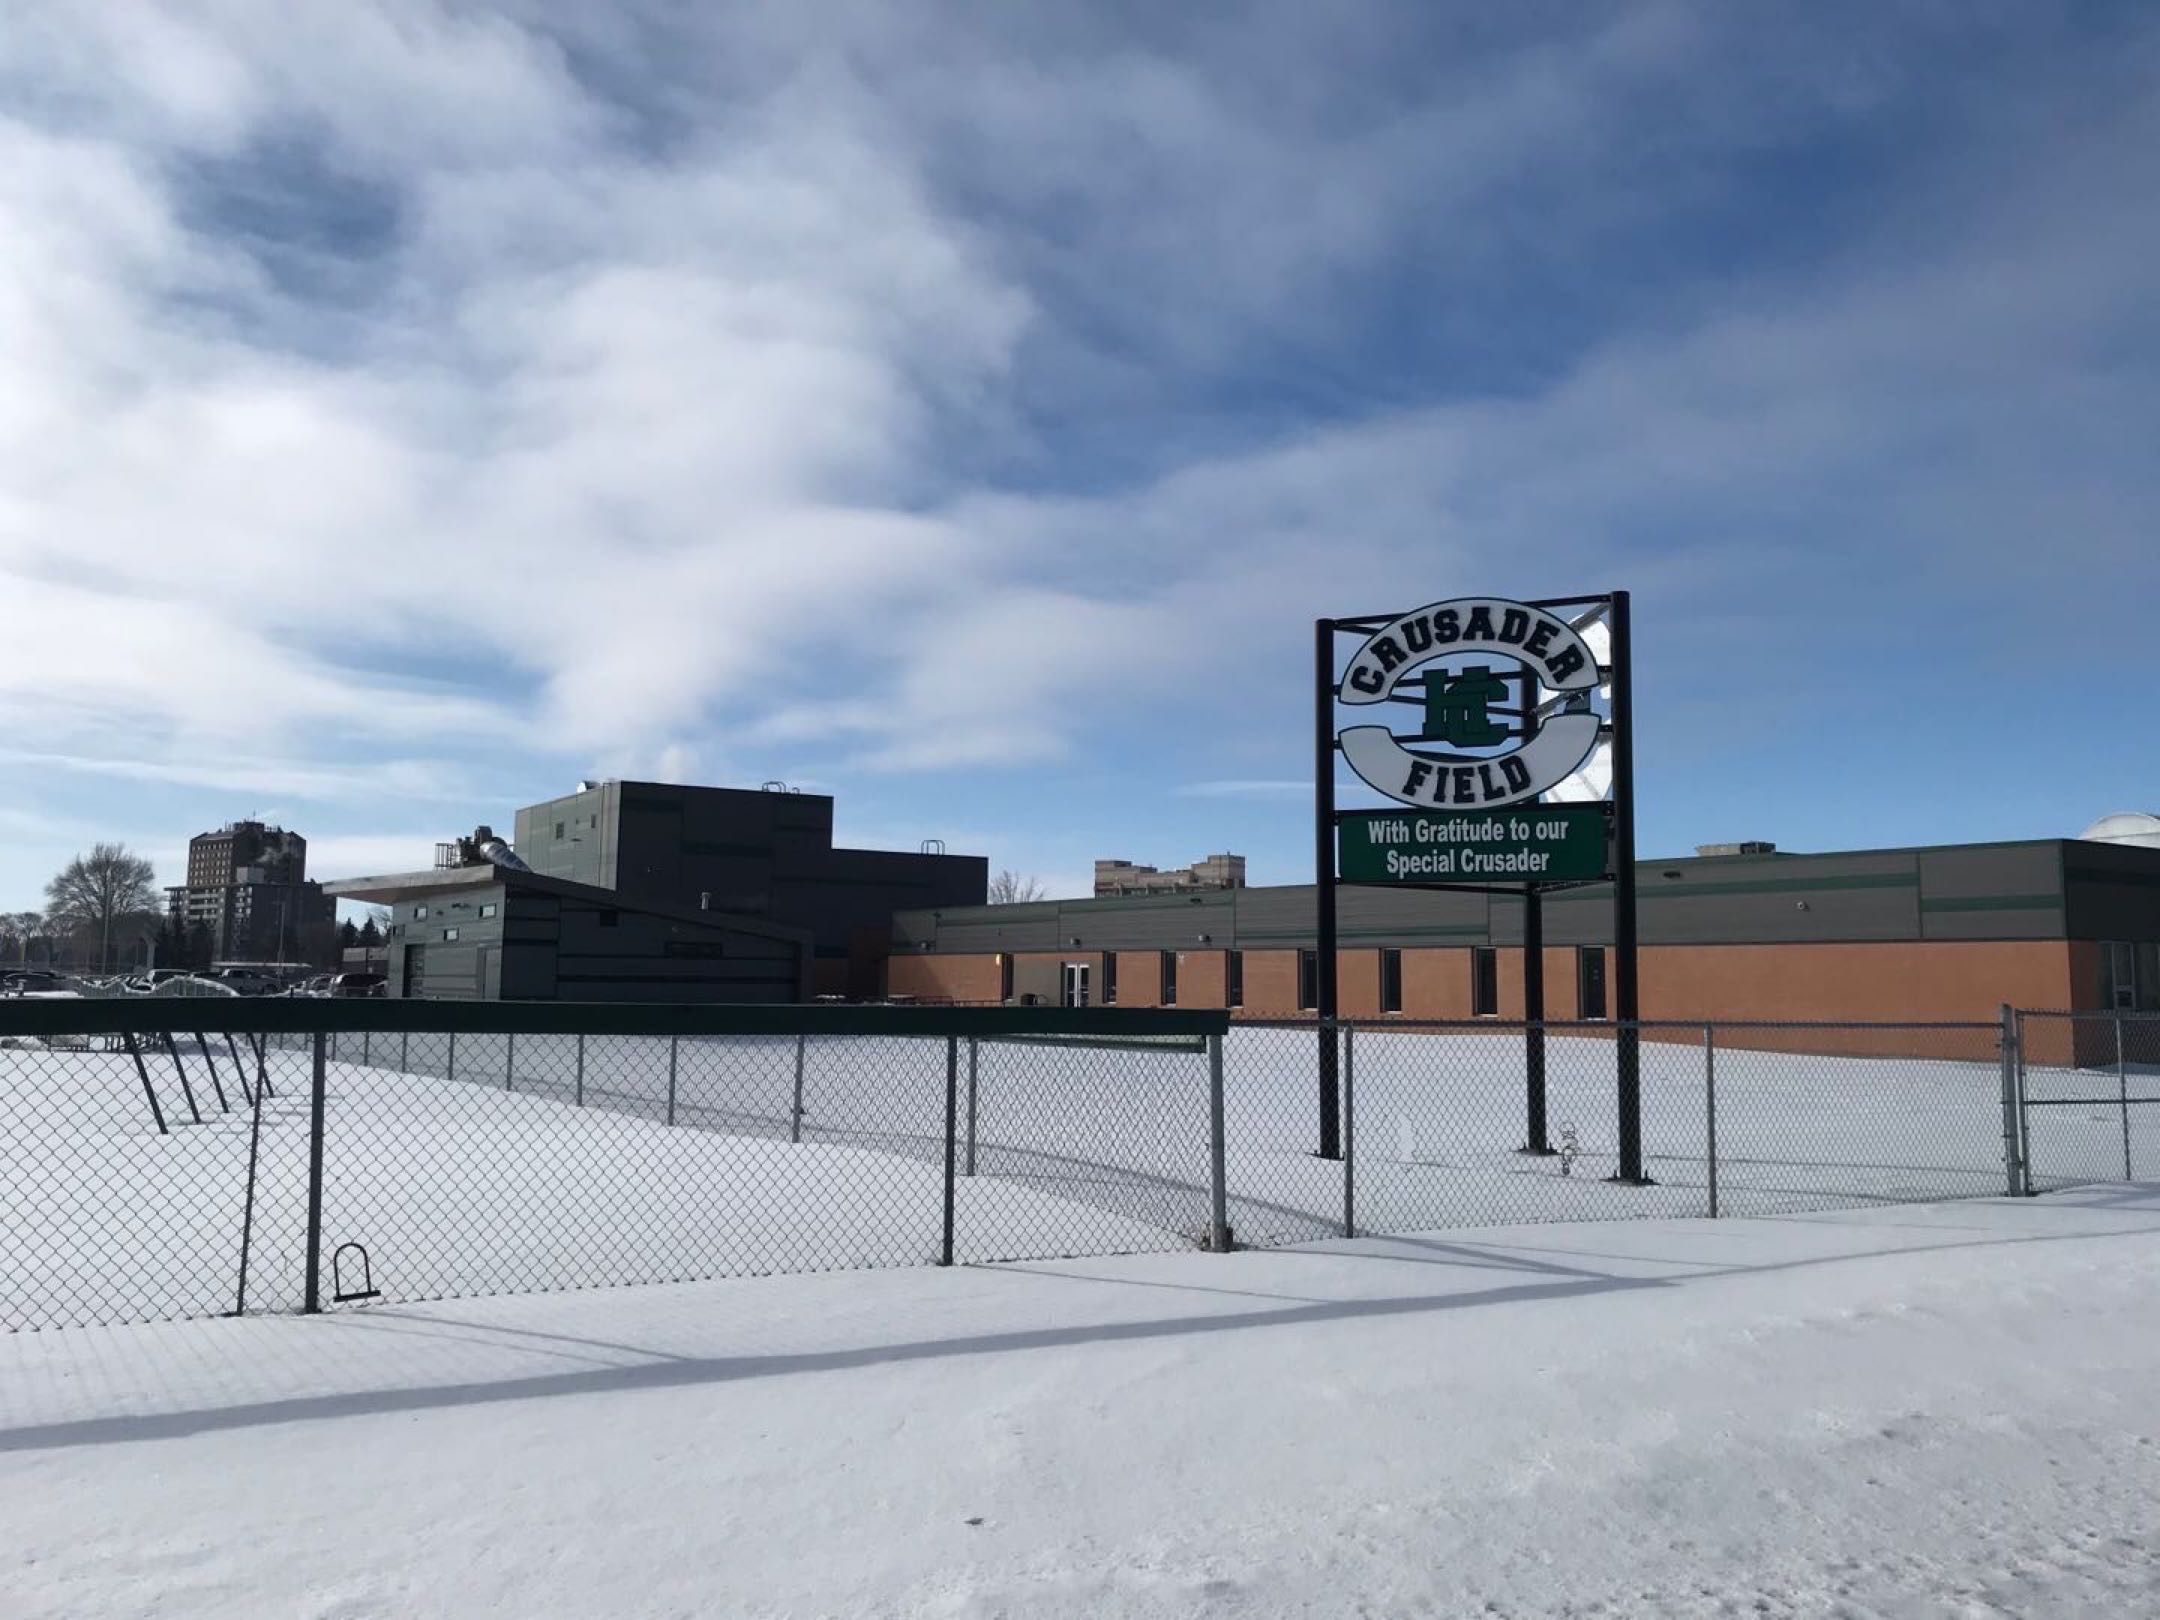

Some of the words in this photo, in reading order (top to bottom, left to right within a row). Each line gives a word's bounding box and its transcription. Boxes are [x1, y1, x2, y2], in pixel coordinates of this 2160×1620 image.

[1351, 607, 1586, 695] CRUSADER
[1402, 755, 1531, 804] FIELD
[1368, 820, 1409, 843] With
[1416, 817, 1503, 841] Gratitude
[1510, 819, 1530, 839] to
[1536, 820, 1569, 839] our
[1387, 849, 1454, 878] Special
[1461, 848, 1550, 873] Crusader
